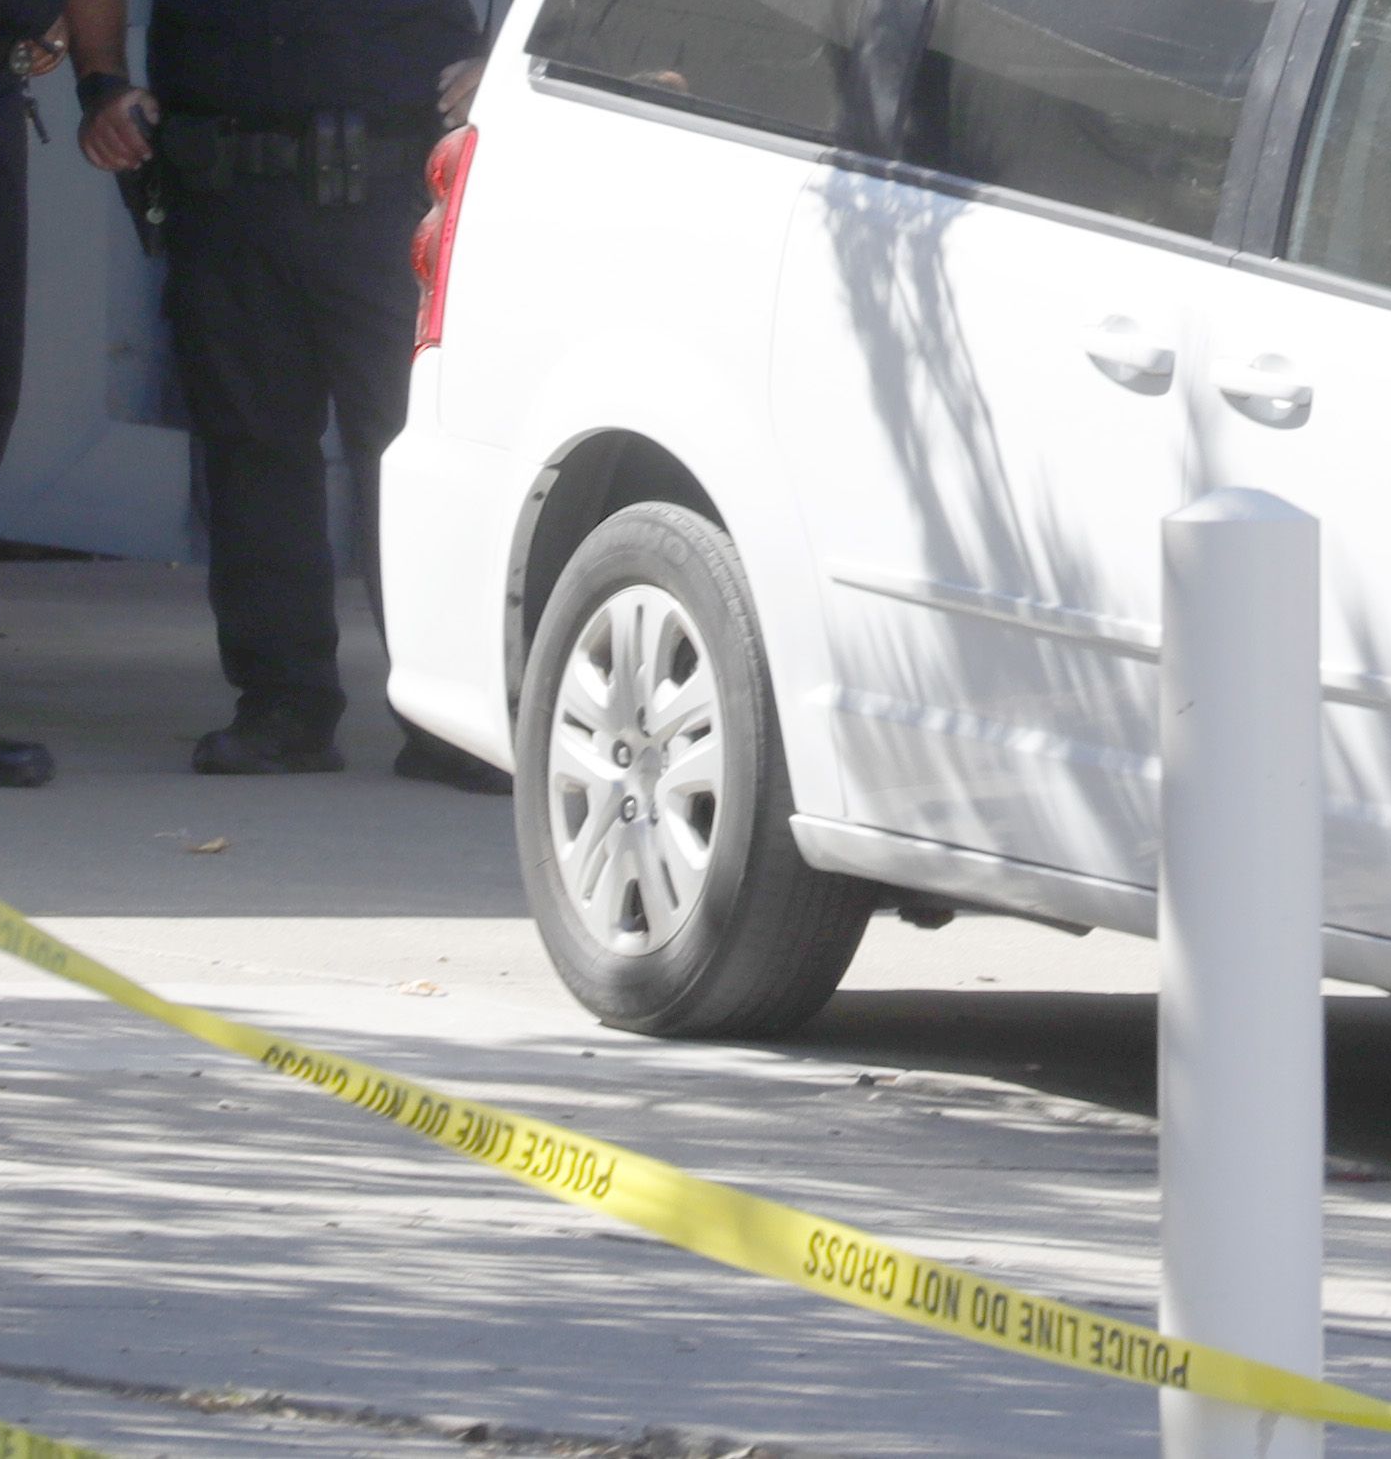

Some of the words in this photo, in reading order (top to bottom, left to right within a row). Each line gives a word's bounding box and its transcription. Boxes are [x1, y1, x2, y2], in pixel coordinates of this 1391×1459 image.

[456, 1110, 515, 1163] LINE
[513, 1131, 617, 1200] POLICE
[804, 1229, 898, 1301] CROSS
[906, 1262, 963, 1322] NOT
[971, 1285, 1008, 1336] DO
[1018, 1300, 1079, 1359] LINE
[1089, 1322, 1191, 1390] POLICE
